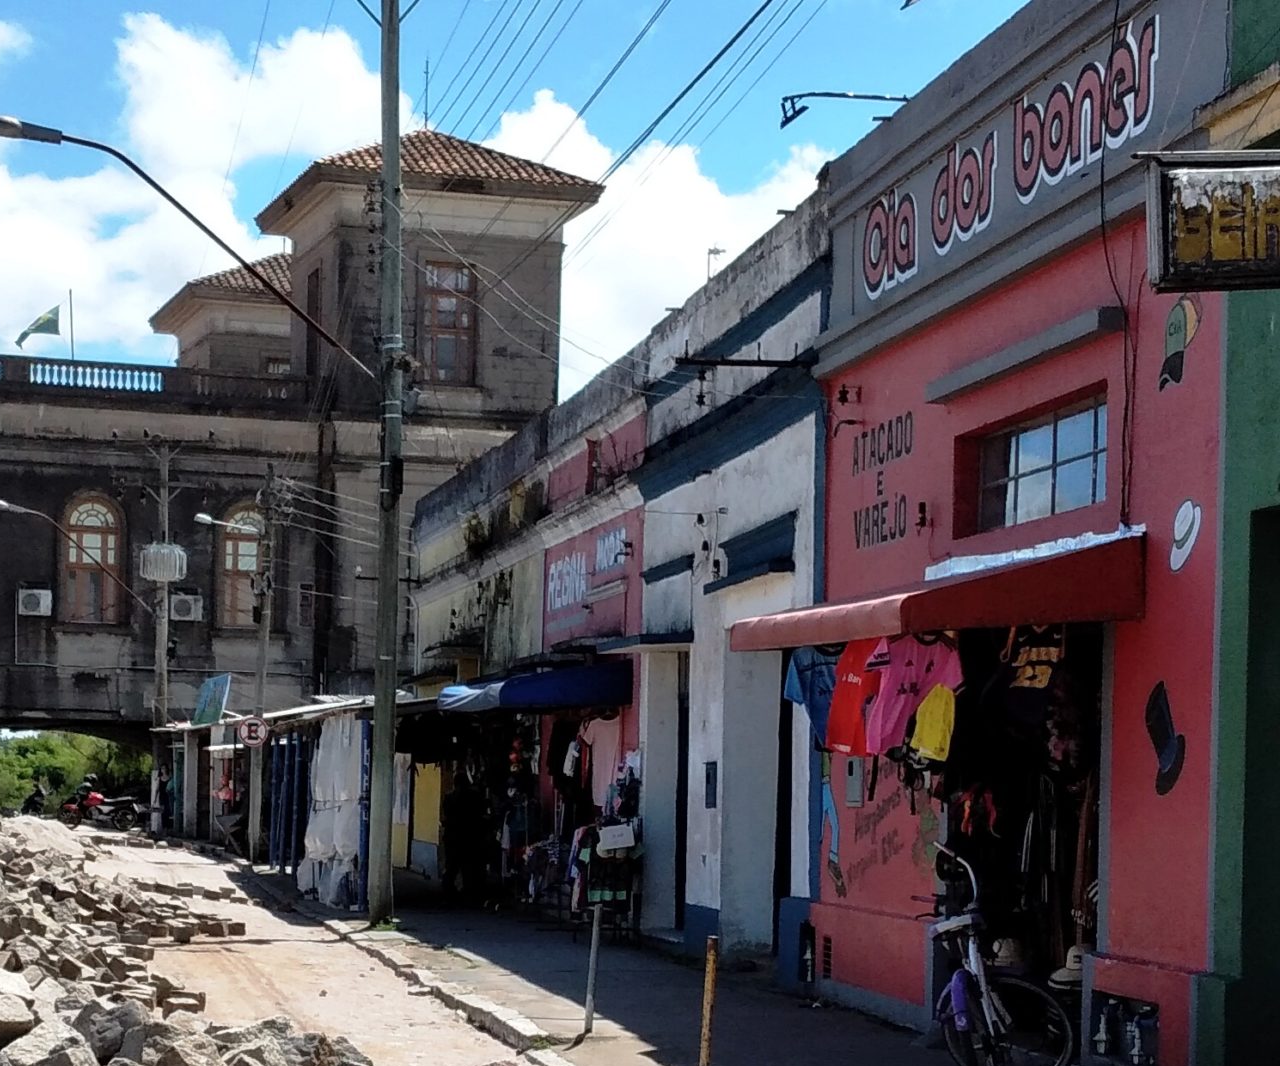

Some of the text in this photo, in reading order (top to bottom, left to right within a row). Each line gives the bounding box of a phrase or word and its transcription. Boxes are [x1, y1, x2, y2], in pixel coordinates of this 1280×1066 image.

[931, 130, 998, 256] dos
[1012, 14, 1160, 204] bonés
[852, 410, 913, 477] ATACADO
[876, 470, 884, 496] E
[247, 722, 259, 740] E
